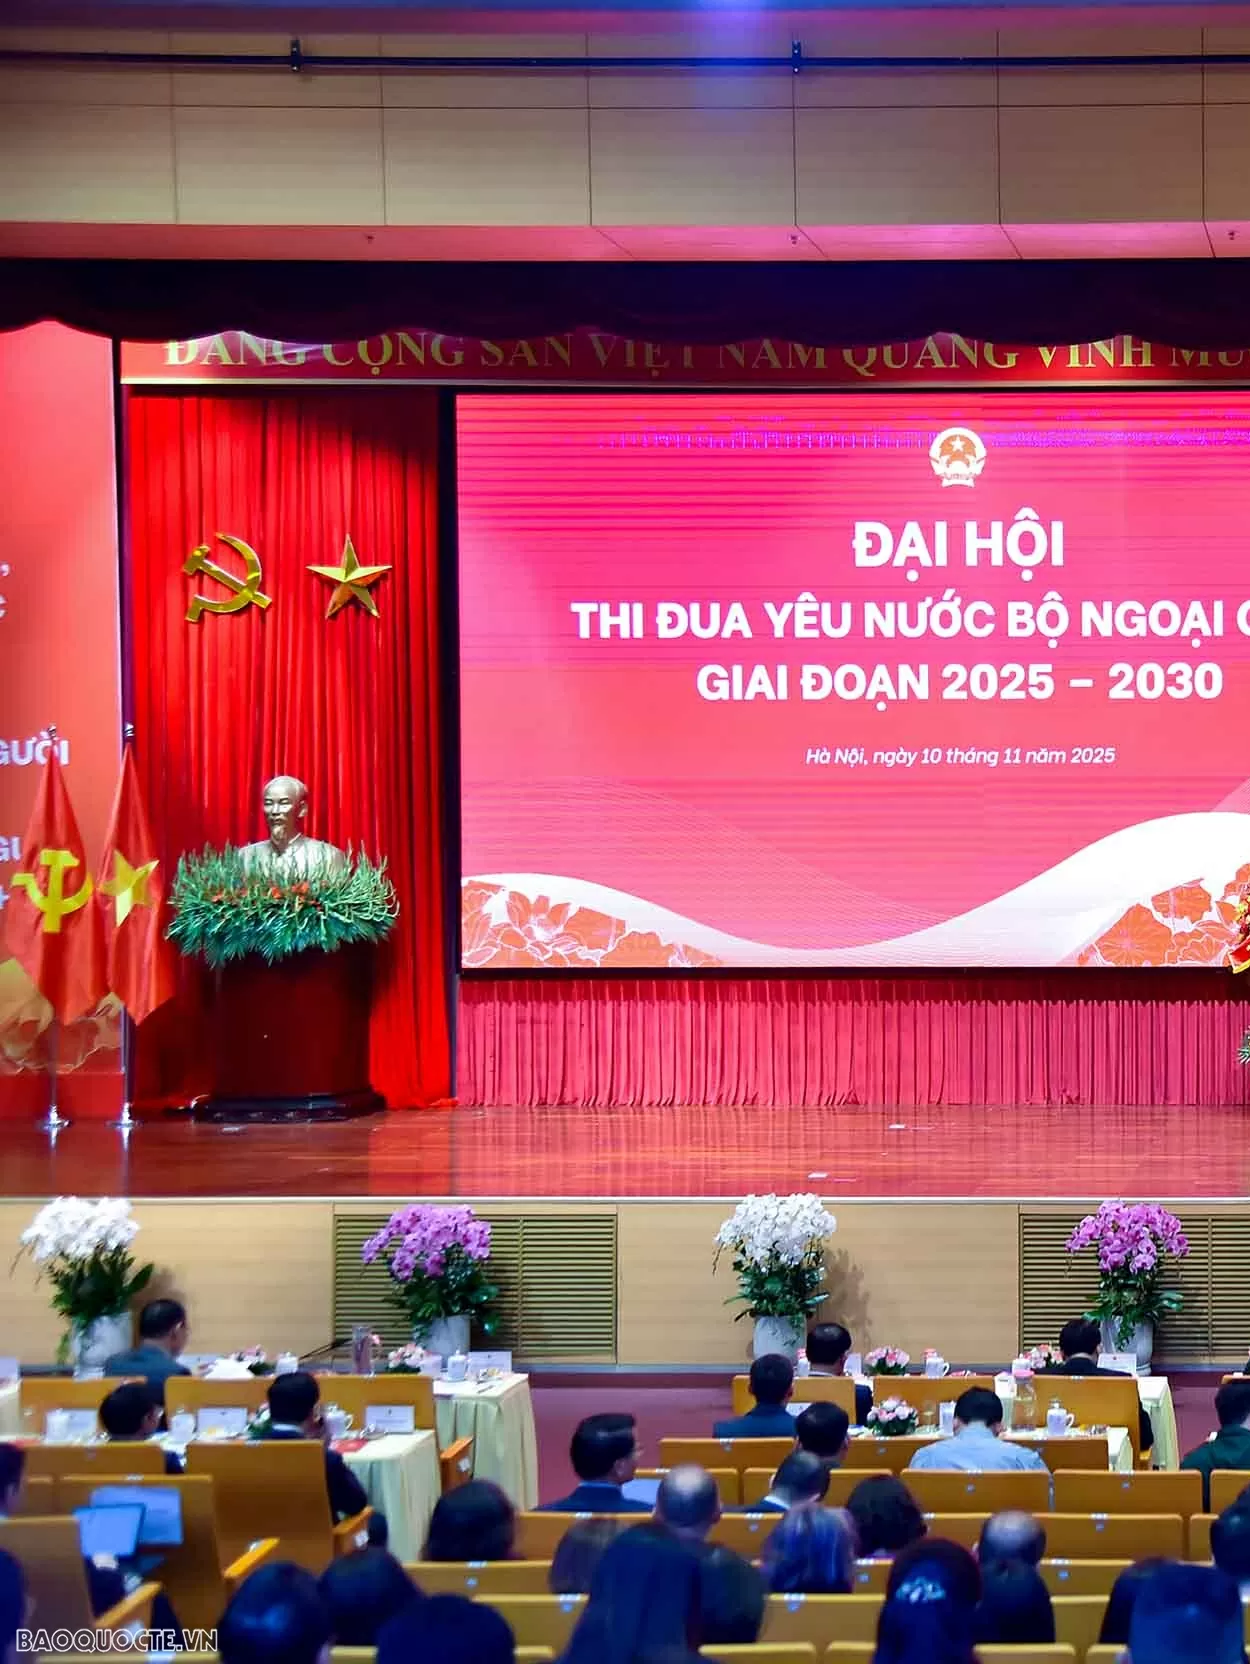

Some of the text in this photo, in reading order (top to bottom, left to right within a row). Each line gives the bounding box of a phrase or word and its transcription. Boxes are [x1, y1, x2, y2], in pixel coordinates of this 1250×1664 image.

[851, 506, 1065, 583] ĐẠI HỘI
[570, 601, 645, 640] THI
[655, 601, 754, 639] ĐUA
[763, 591, 853, 639] YÊU
[863, 587, 996, 639] NƯỚC
[1006, 590, 1070, 650] BỘ
[1080, 599, 1225, 649] NGOẠI
[696, 663, 789, 701] GIAI
[799, 662, 931, 712] ĐOẠN
[940, 662, 1056, 701] 2025
[1107, 661, 1224, 701] 2030
[805, 746, 1117, 769] Hà Nội, ngày 10 tháng 11 năm 2025
